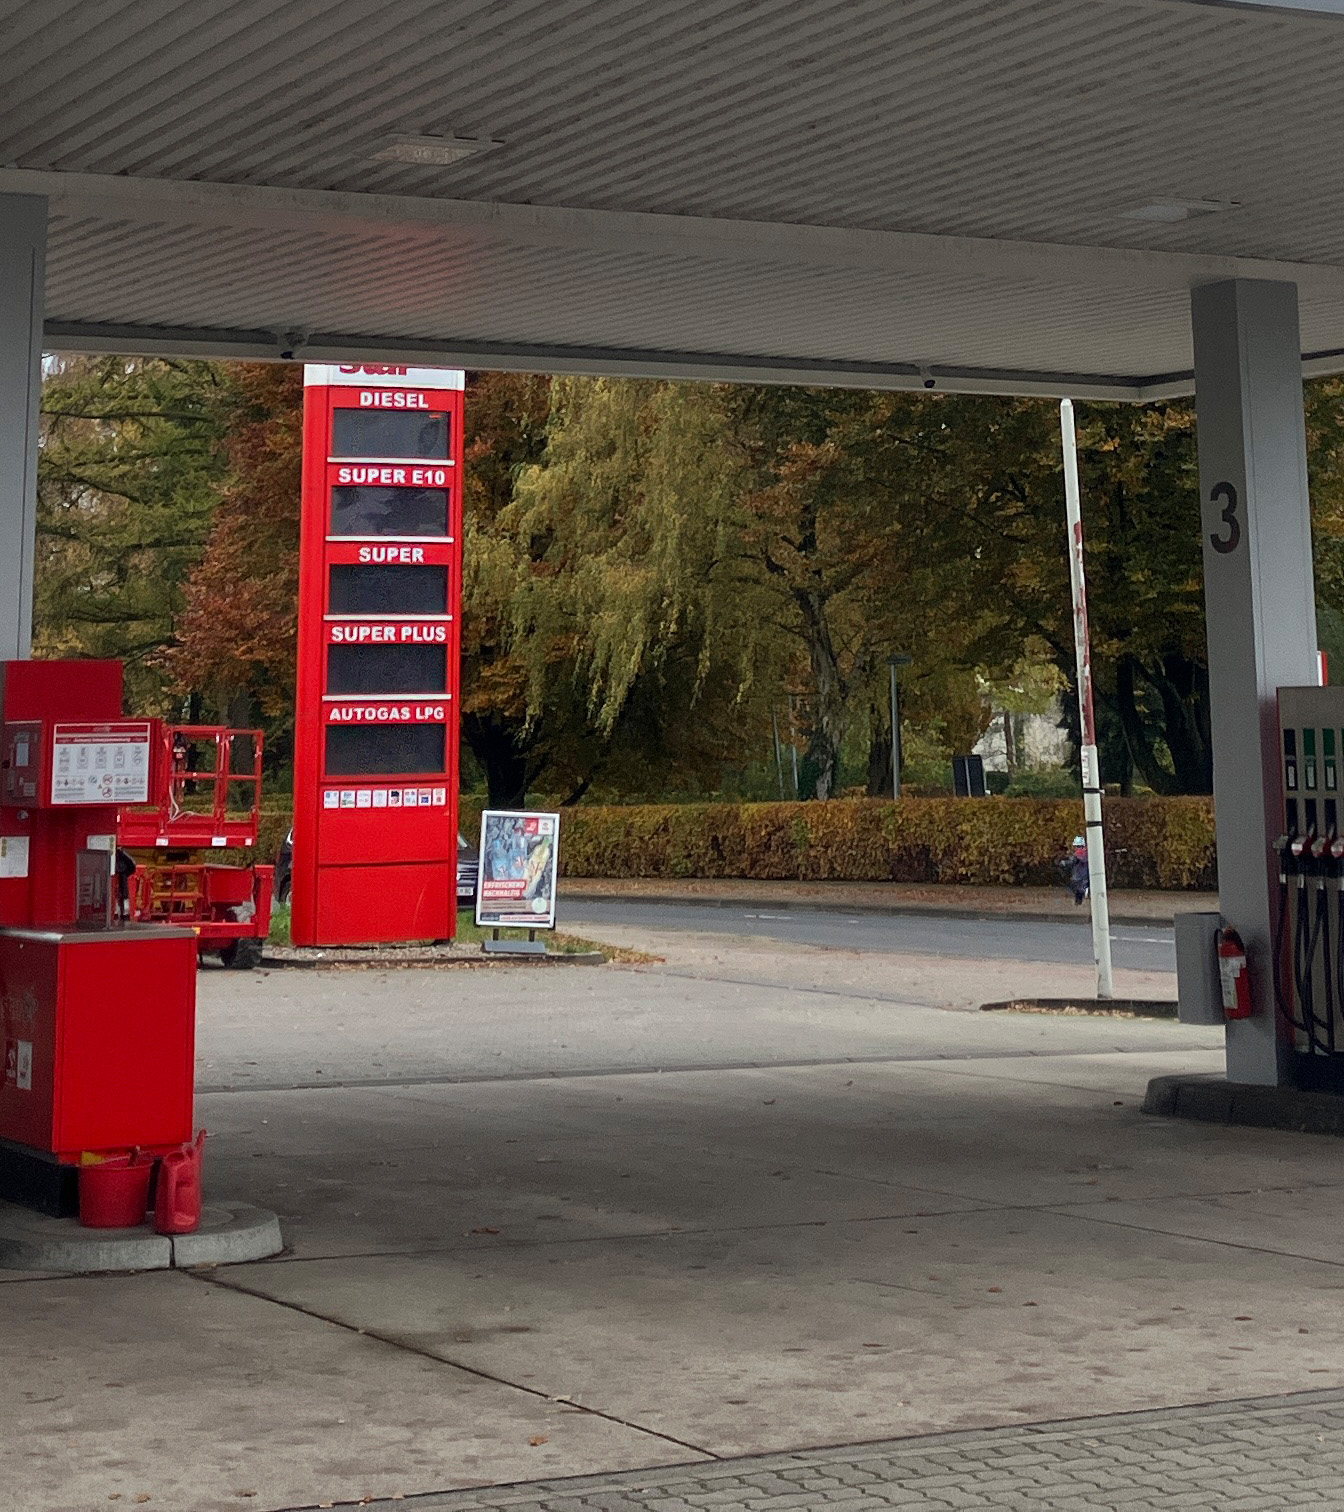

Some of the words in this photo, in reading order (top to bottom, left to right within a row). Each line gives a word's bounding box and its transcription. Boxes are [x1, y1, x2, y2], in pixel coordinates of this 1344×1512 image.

[359, 392, 429, 408] DIESEL
[338, 468, 406, 484] SUPER
[412, 470, 445, 485] E10
[1210, 481, 1240, 554] 3
[359, 547, 424, 563] SUPER
[331, 626, 396, 642] SUPER
[401, 626, 446, 642] PLUS
[329, 707, 411, 721] AUTOGAS
[415, 706, 445, 720] LPG
